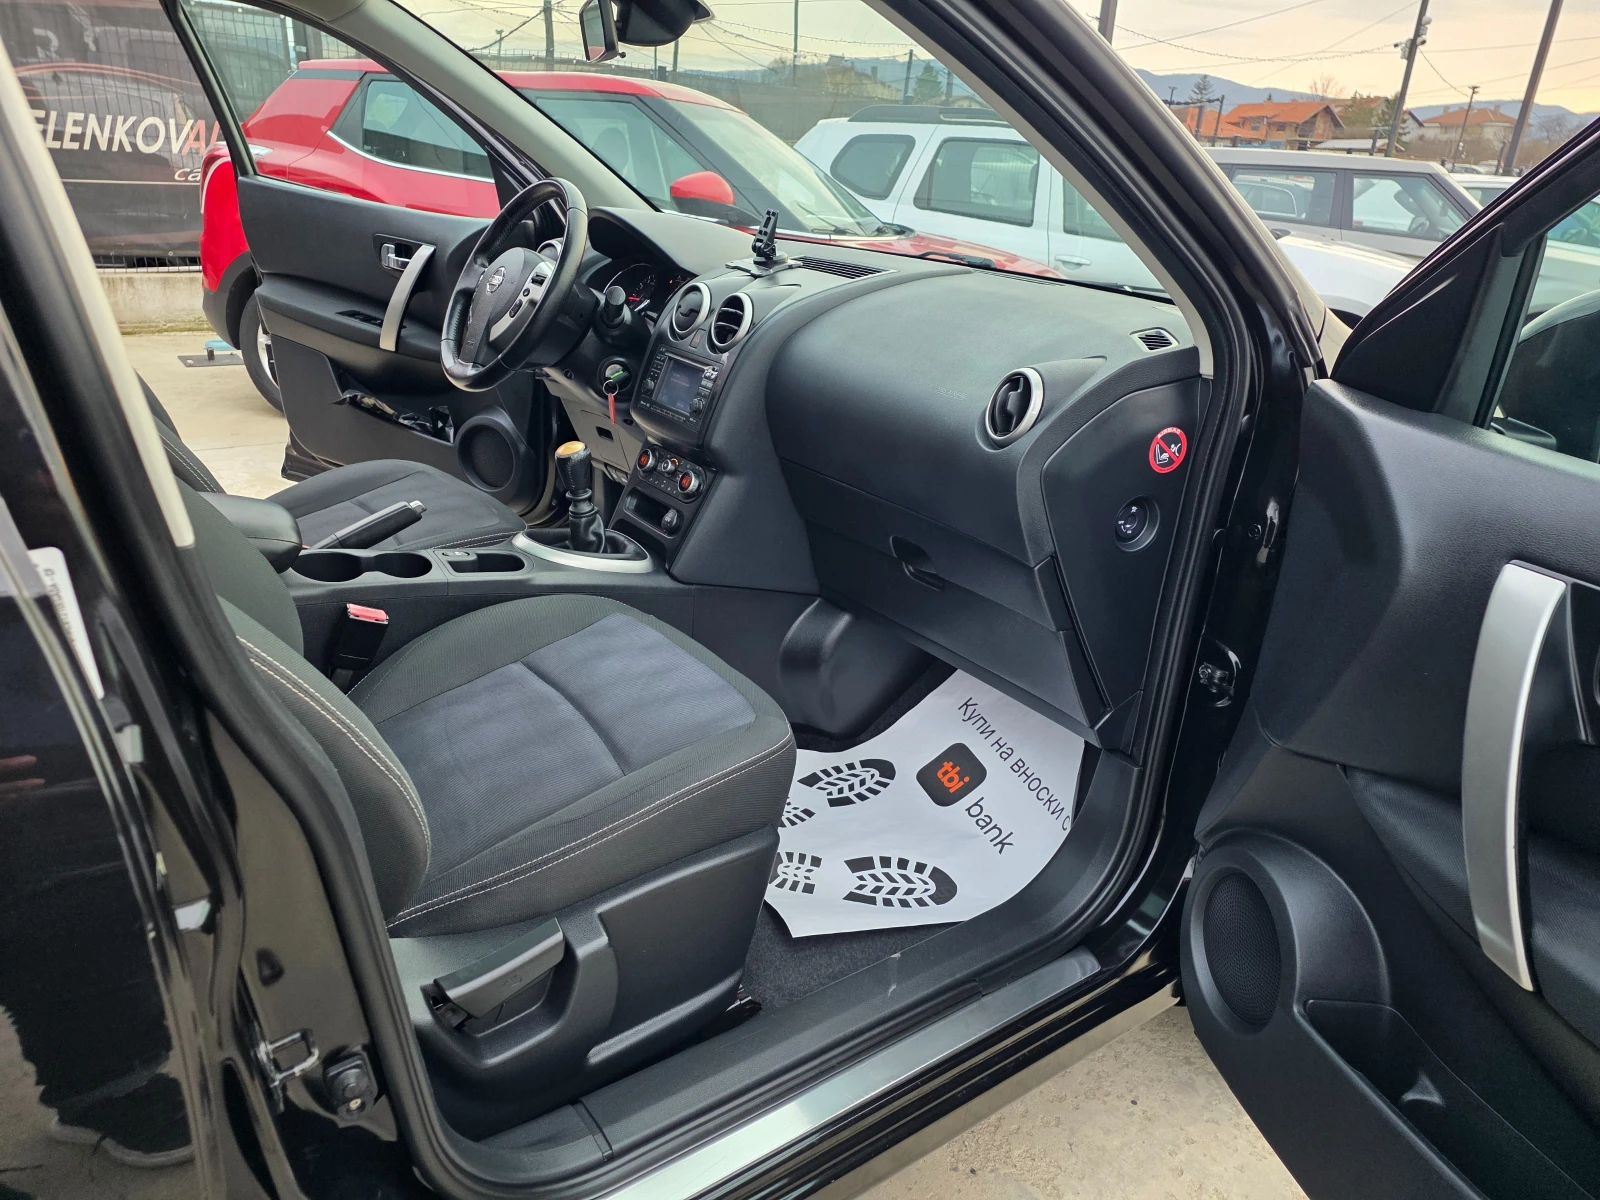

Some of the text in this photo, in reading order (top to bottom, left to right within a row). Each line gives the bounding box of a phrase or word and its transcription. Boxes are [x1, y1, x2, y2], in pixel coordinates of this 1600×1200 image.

[936, 761, 1015, 855] tbi bank
[957, 696, 996, 740] Купи
[990, 736, 1014, 762] на
[1009, 757, 1065, 821] вноски
